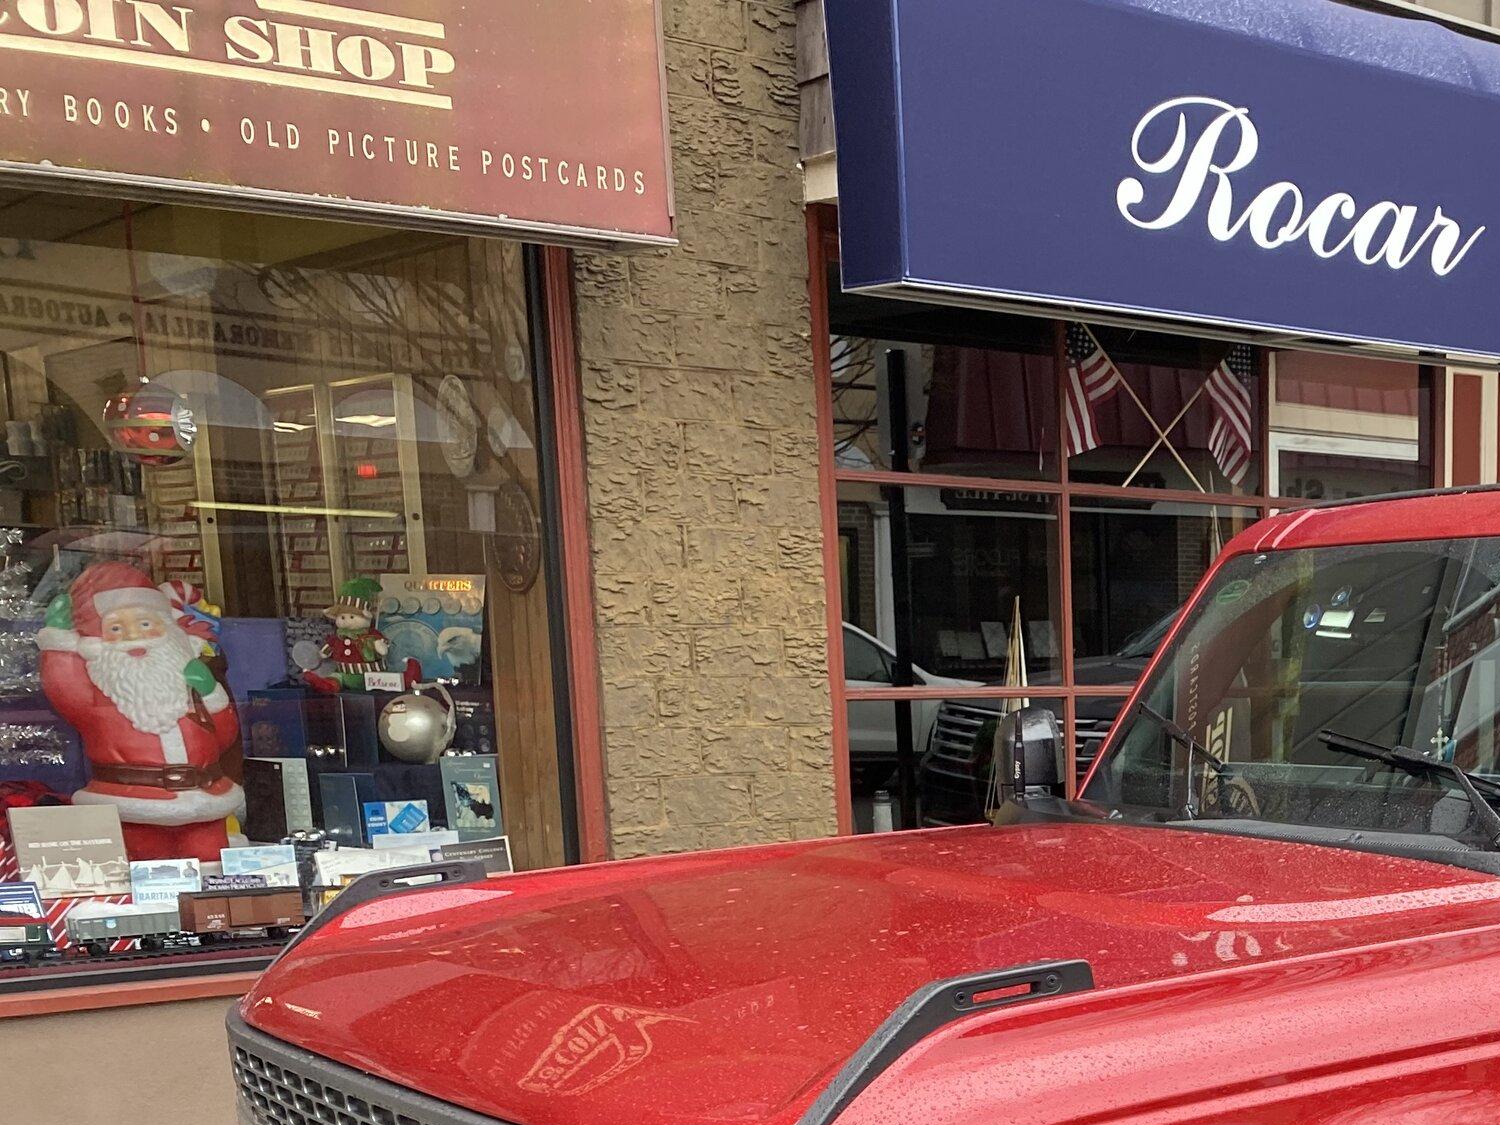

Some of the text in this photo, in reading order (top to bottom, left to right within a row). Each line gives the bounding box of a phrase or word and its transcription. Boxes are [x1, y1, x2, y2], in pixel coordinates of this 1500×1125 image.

[0, 0, 455, 88] OIN SHOP
[64, 94, 178, 135] BOOKS
[240, 117, 300, 149] OLD
[328, 129, 460, 171] PICTURE
[482, 150, 645, 195] POSTCARDS
[1116, 96, 1486, 276] Rocar
[404, 580, 472, 593] QUARTERS
